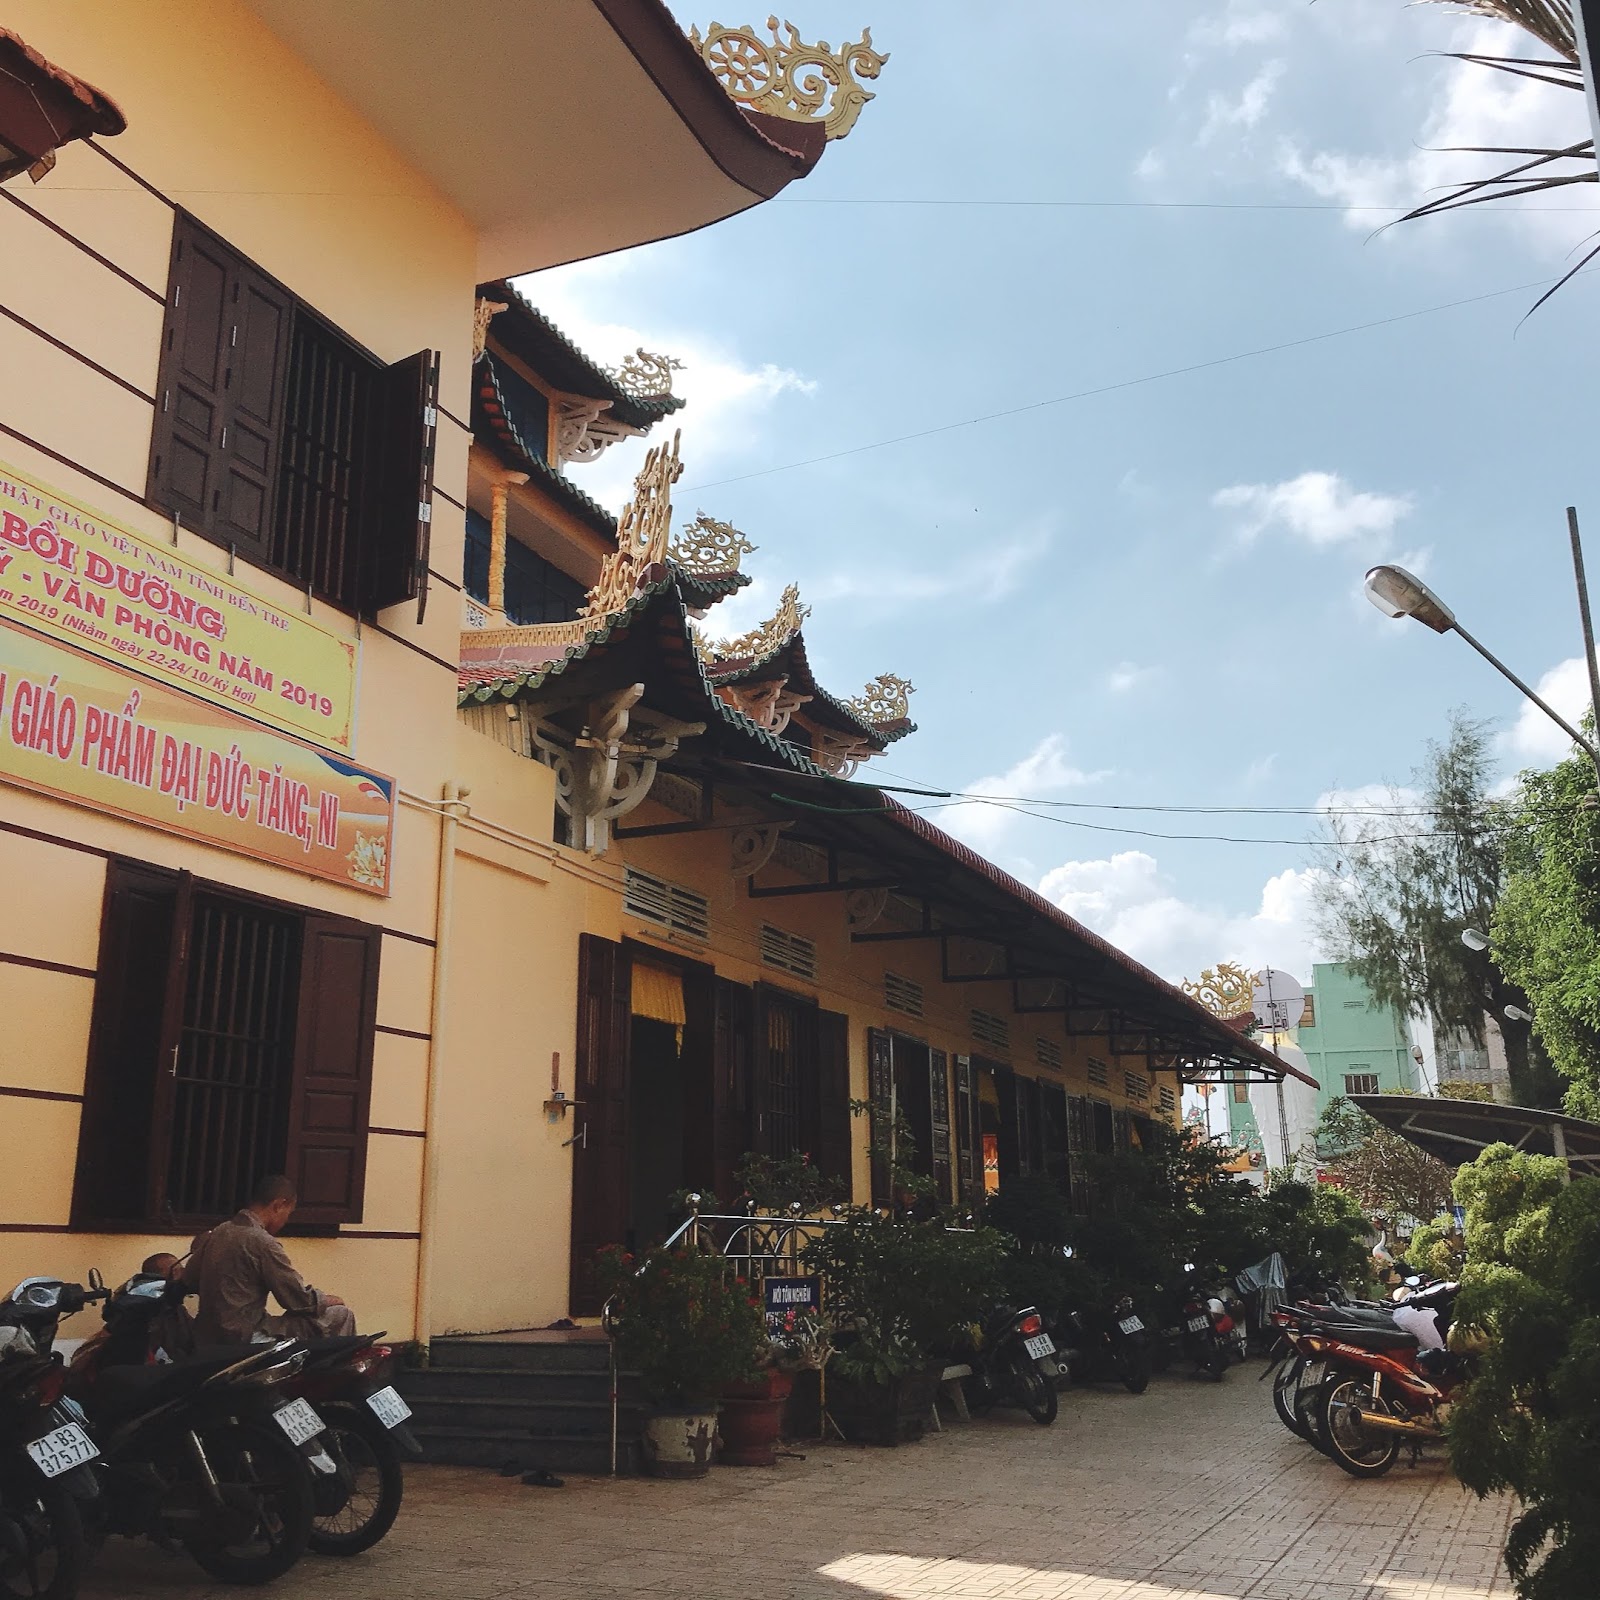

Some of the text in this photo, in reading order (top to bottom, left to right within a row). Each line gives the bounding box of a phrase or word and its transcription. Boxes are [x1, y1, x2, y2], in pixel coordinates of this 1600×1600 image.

[0, 481, 289, 631] HẬT GIÁO VIỆT NAM TỈNH BẾN TRE
[0, 510, 226, 639] BỒI DƯỠNG
[16, 595, 59, 619] 2019
[62, 613, 108, 641] (Nhằm
[110, 636, 144, 657] ngày
[43, 571, 106, 619] VĂN
[114, 604, 211, 665] PHÒNG
[218, 650, 274, 692] NĂM
[280, 680, 333, 717] 2019
[11, 674, 76, 760] GIÁO
[81, 689, 157, 787] PHẨM
[159, 735, 202, 811] ĐẠI
[205, 744, 251, 819] ĐỨC
[258, 763, 312, 851] TĂNG,
[317, 792, 339, 848] NI
[33, 1429, 77, 1457] 71-B3
[41, 1440, 91, 1473] 375.77
